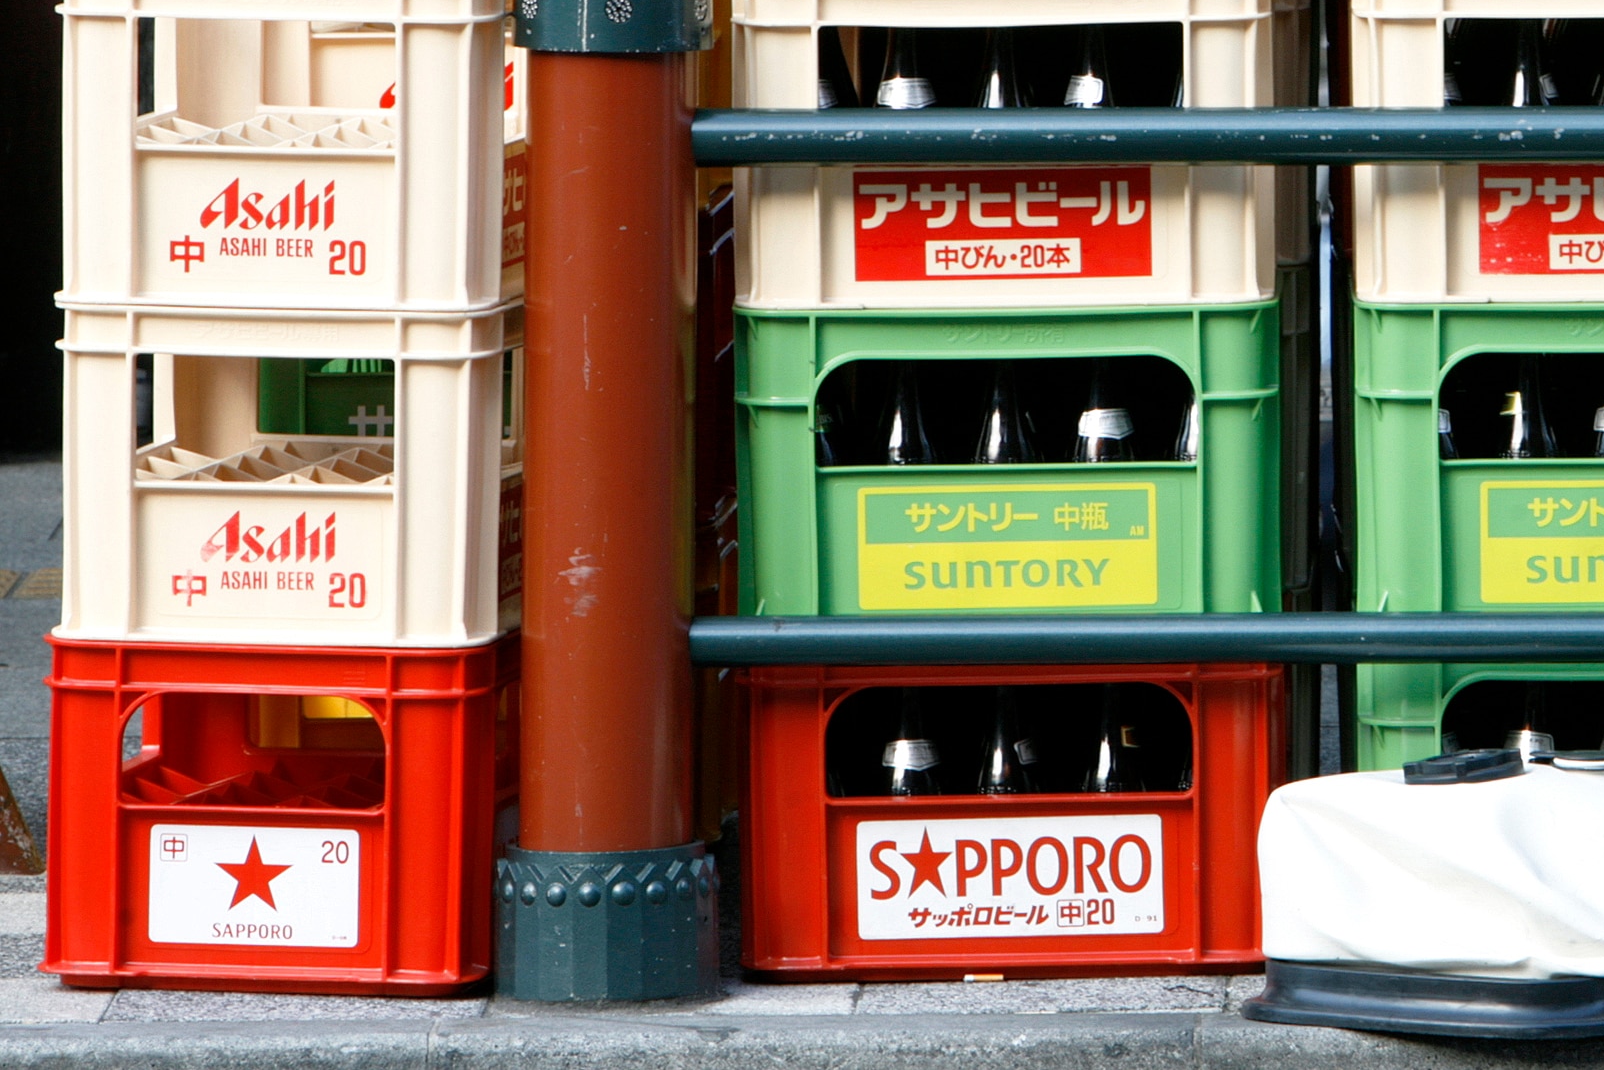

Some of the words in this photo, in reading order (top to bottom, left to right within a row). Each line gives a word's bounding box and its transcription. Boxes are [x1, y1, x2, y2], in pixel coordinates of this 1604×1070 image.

[200, 177, 335, 231] Asahi
[859, 180, 1145, 229] アサヒビール
[169, 235, 205, 273] 中
[219, 237, 267, 257] ASAHI
[276, 238, 313, 257] BEER
[329, 240, 366, 276] 20
[935, 243, 1070, 270] 中びん・20本
[905, 502, 1038, 532] サントリー
[1054, 501, 1109, 531] 中瓶
[200, 510, 336, 563] Asahi
[171, 568, 207, 607] 中
[221, 571, 268, 590] ASAHI
[277, 571, 314, 590] BEER
[328, 573, 366, 608] 20
[163, 836, 185, 859] 中
[321, 840, 349, 864] 20
[212, 922, 293, 940] SAPPORO
[908, 903, 1049, 928] サッポロビール
